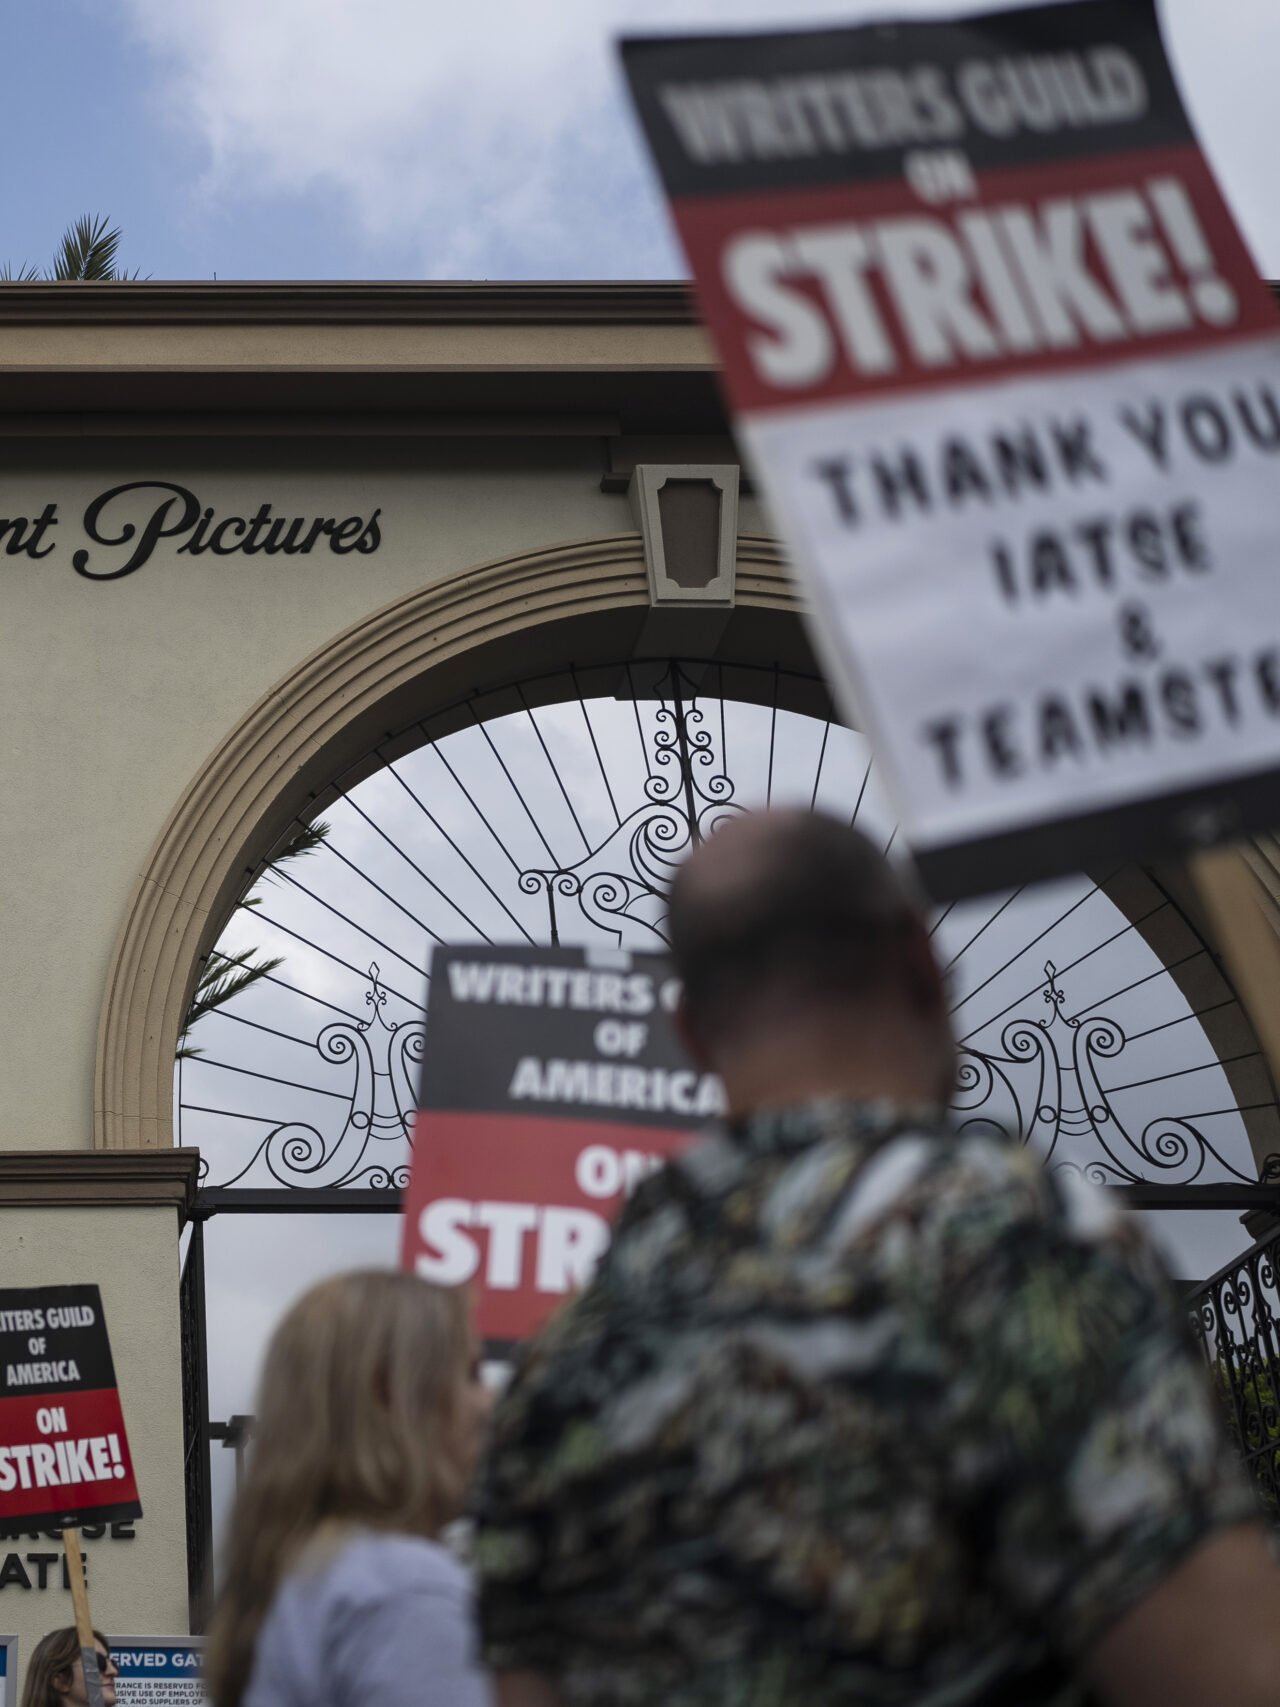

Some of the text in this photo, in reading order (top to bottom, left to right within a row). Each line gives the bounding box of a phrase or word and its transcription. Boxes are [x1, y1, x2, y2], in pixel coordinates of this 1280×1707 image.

[659, 45, 1147, 163] WRITERS GUILD
[904, 148, 978, 204] ON
[724, 176, 1238, 388] STRIKE!
[812, 380, 1280, 529] THANK YOU
[72, 481, 382, 580] Pictures
[990, 502, 1210, 608] IATSE
[1121, 604, 1160, 664] &
[925, 644, 1280, 795] TEAMSTE
[449, 961, 655, 1015] WRITERS
[594, 1020, 648, 1057] OF
[510, 1058, 730, 1118] AMERICA
[46, 1305, 96, 1329] GUILD
[6, 1359, 81, 1387] AMERICA
[28, 1337, 47, 1356] OF
[36, 1406, 68, 1435] ON
[109, 1652, 167, 1667] ERVED
